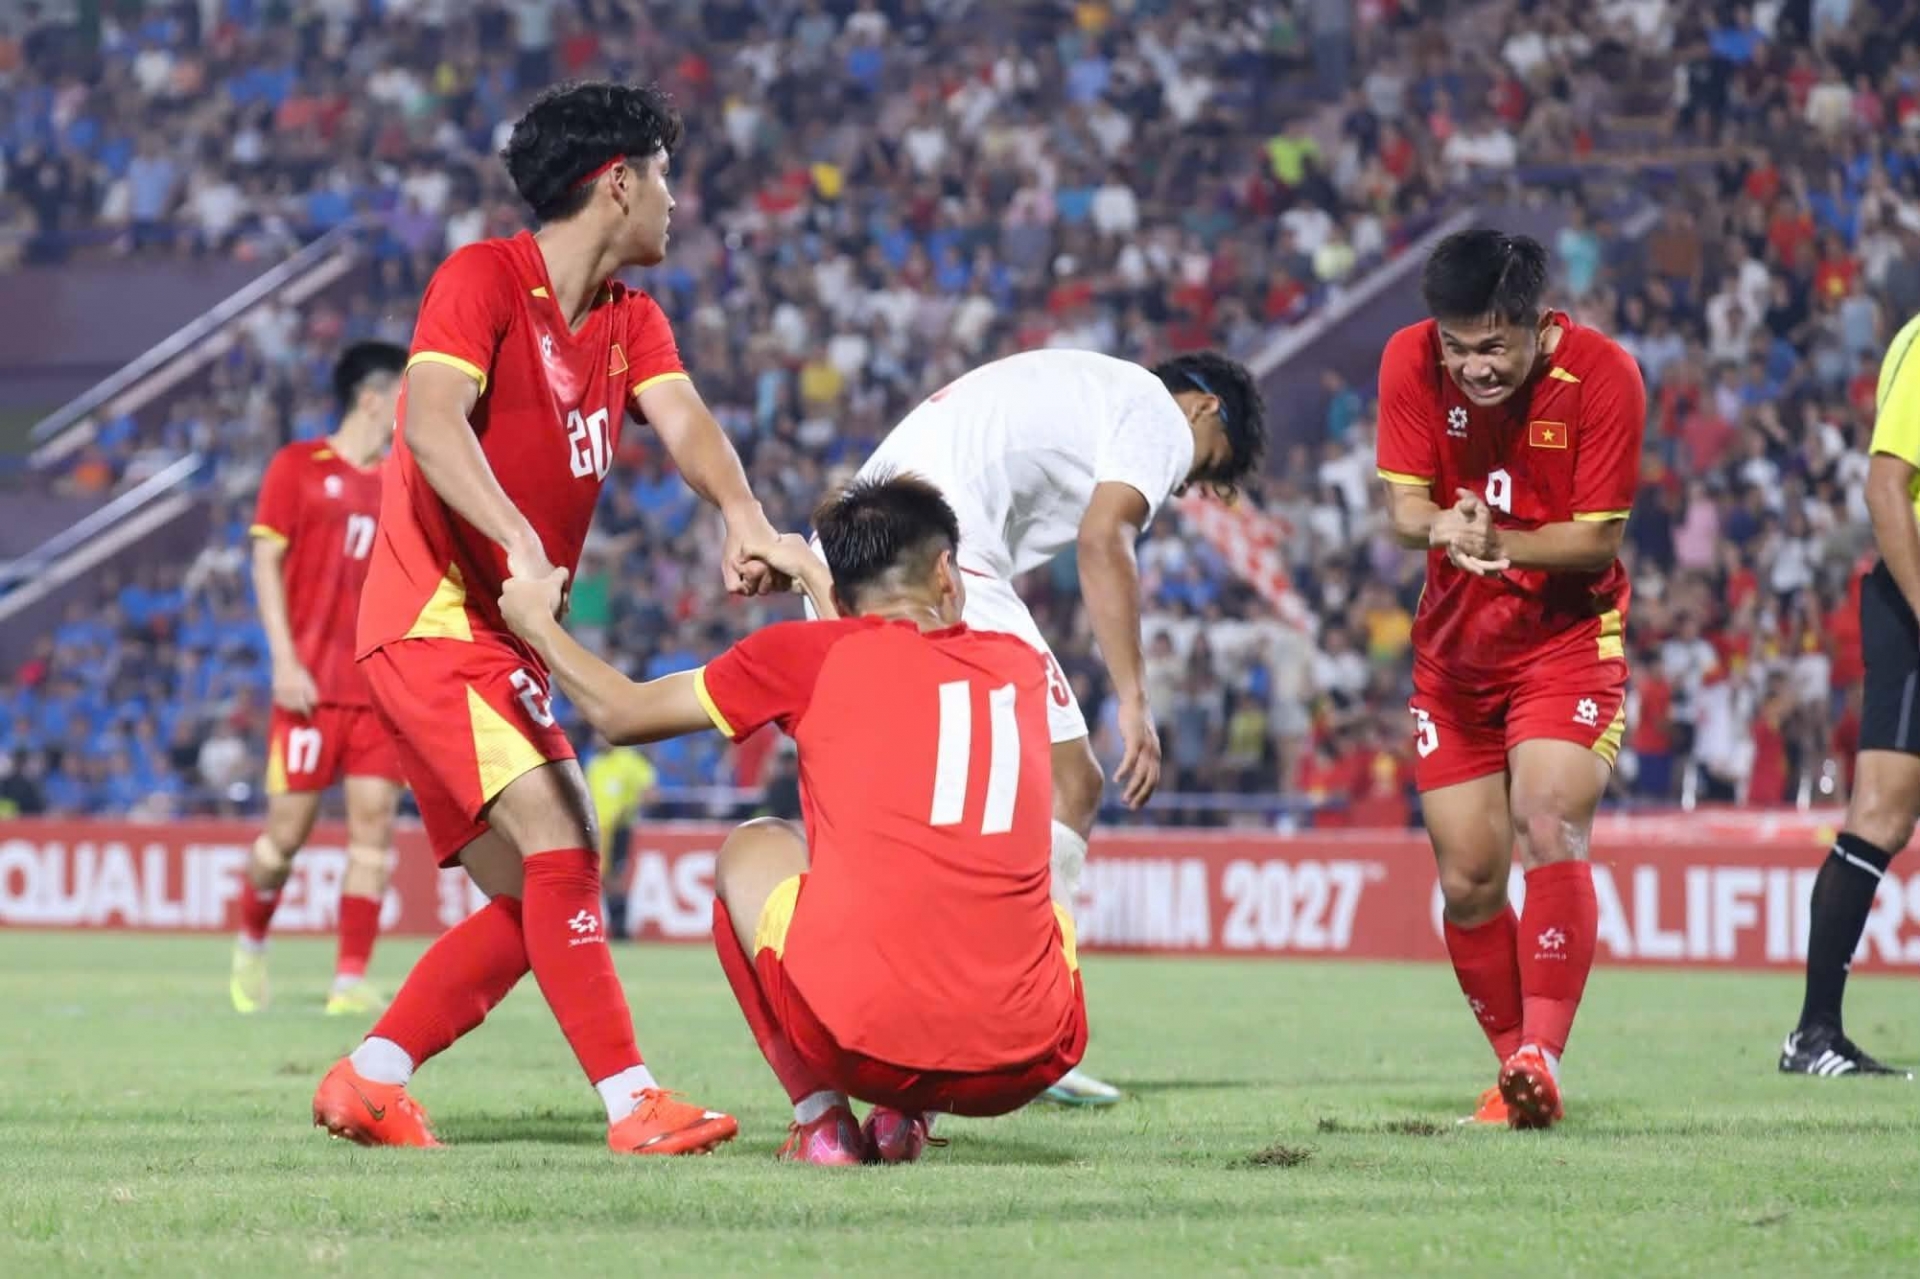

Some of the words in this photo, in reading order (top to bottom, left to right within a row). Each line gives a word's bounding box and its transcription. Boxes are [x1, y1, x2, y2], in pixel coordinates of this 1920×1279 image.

[567, 407, 614, 482] 20
[929, 680, 1021, 836] 11
[0, 839, 402, 929] QUALIFER
[1221, 859, 1365, 950] 2027
